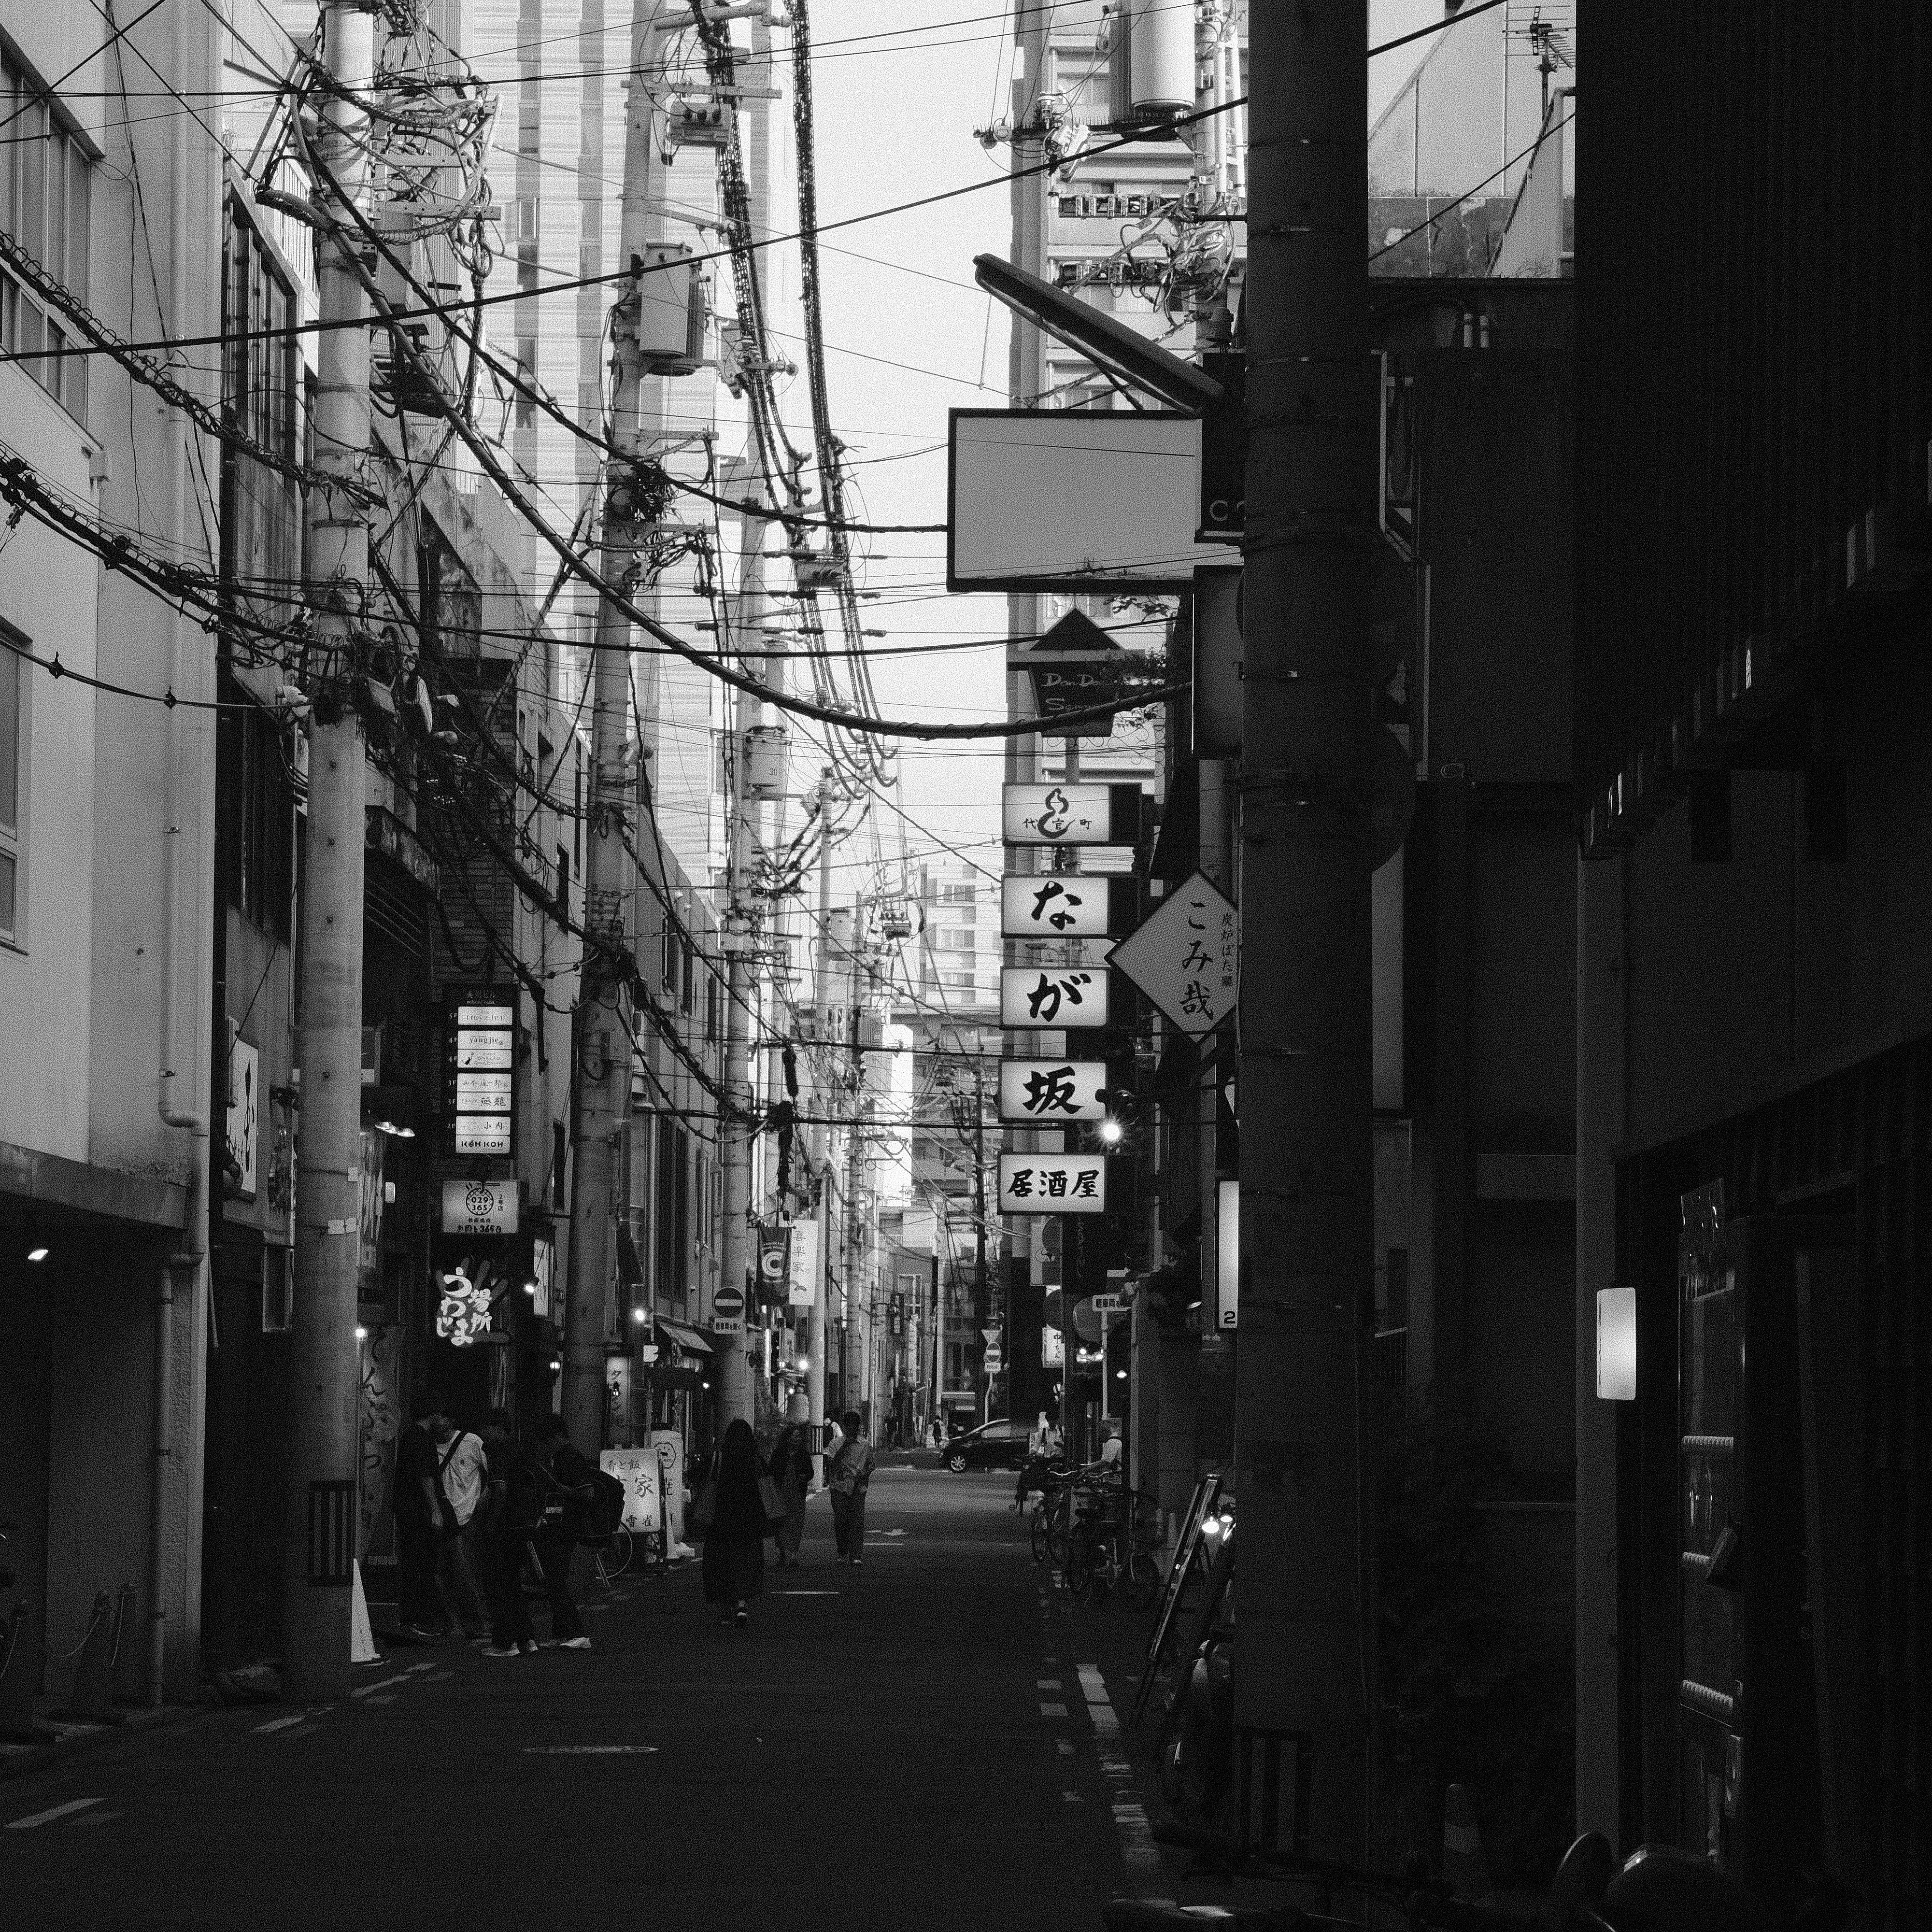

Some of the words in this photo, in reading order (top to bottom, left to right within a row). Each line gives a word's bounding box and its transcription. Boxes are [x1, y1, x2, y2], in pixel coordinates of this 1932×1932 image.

[1023, 818, 1092, 830] 代官町
[1008, 1169, 1099, 1198] 居酒屋
